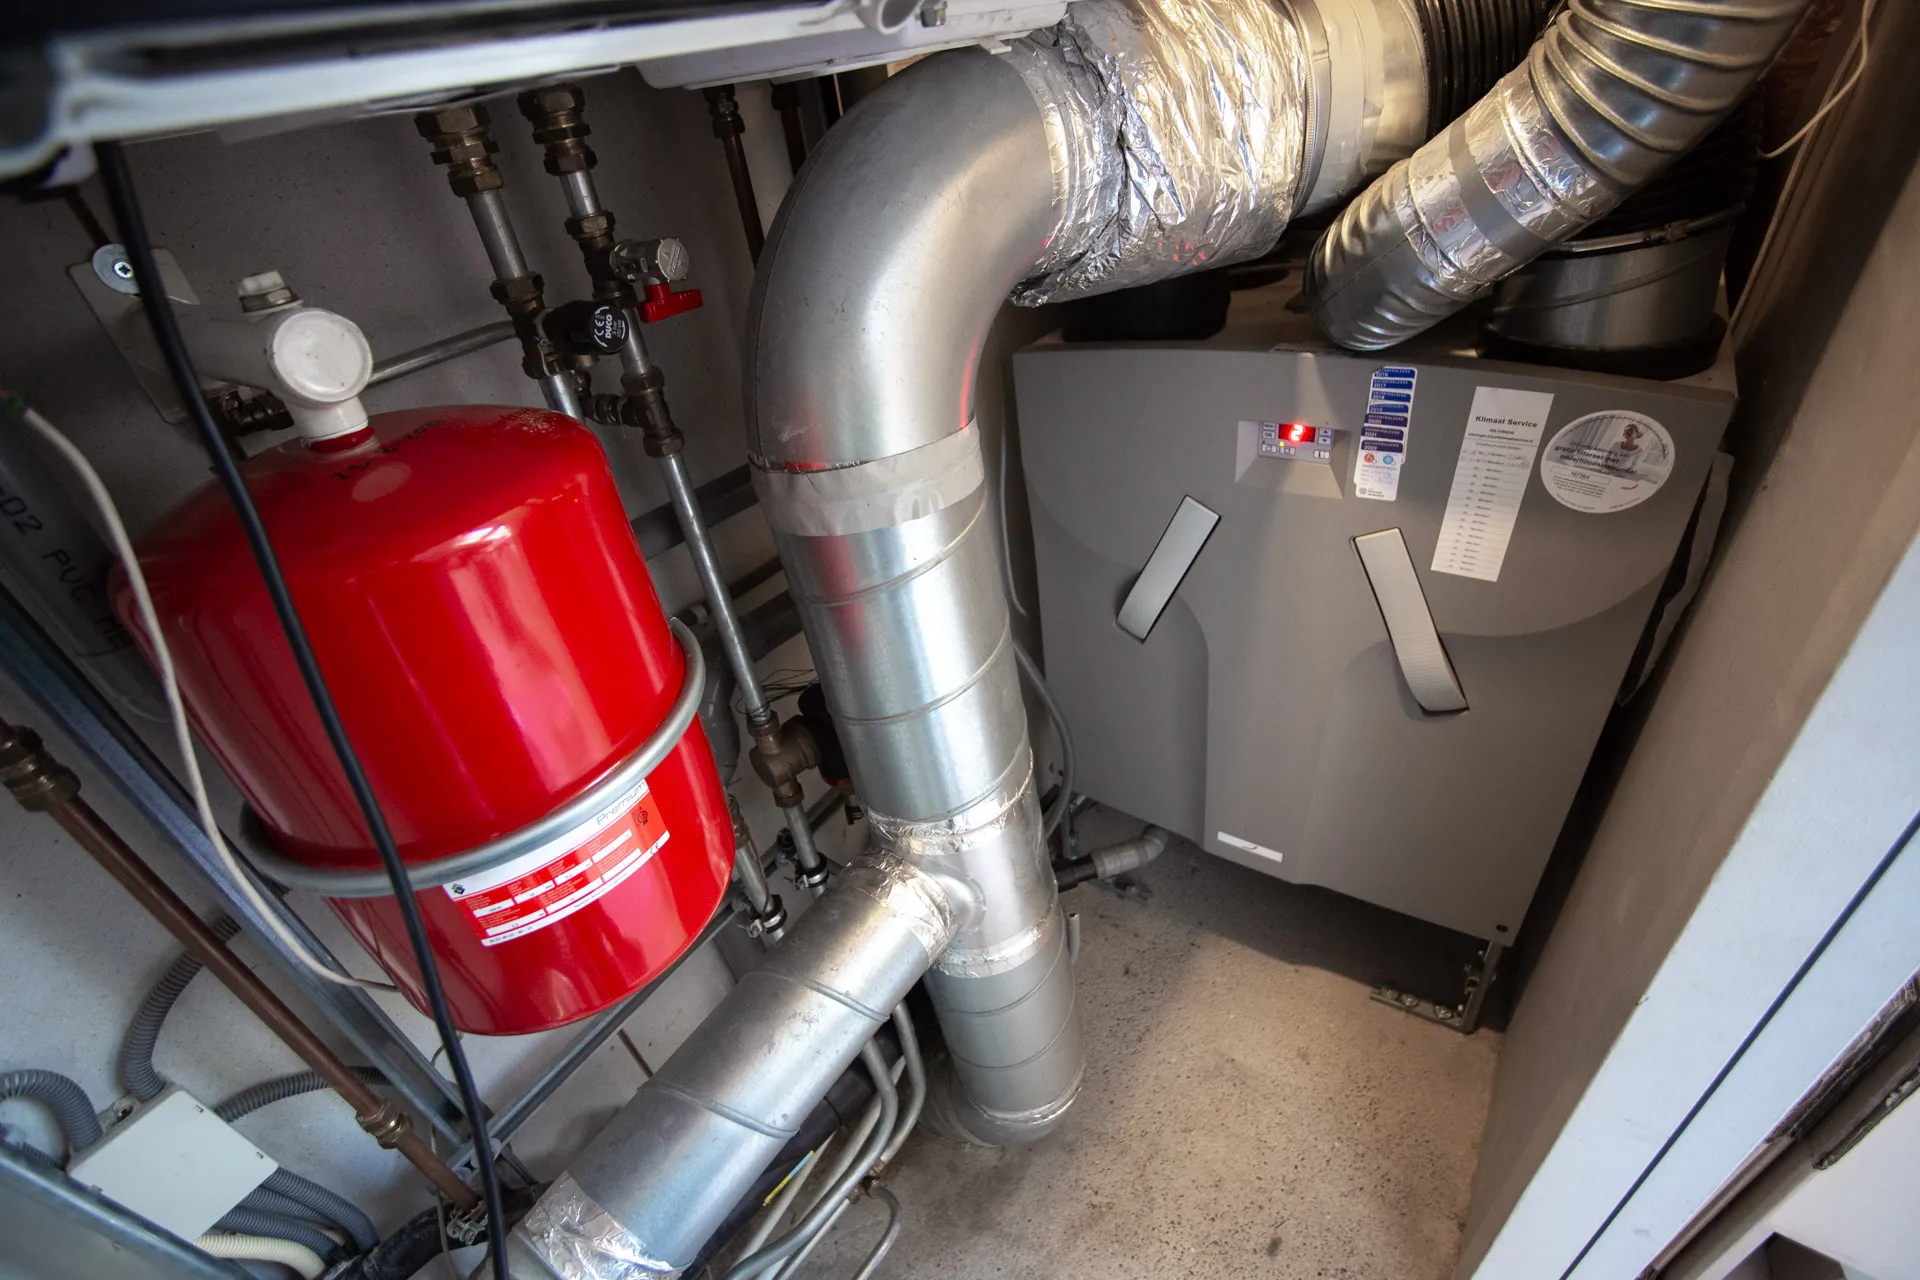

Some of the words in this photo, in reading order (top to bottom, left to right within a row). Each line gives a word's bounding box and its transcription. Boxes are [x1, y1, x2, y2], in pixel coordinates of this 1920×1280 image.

[604, 313, 613, 339] DUCO
[1475, 415, 1506, 425] Klimaat
[1507, 419, 1538, 428] Service
[1290, 424, 1304, 441] 2
[1554, 445, 1577, 454] gratis
[1576, 449, 1604, 461] filterset
[43, 548, 97, 602] PVC
[596, 781, 647, 827] Premium
